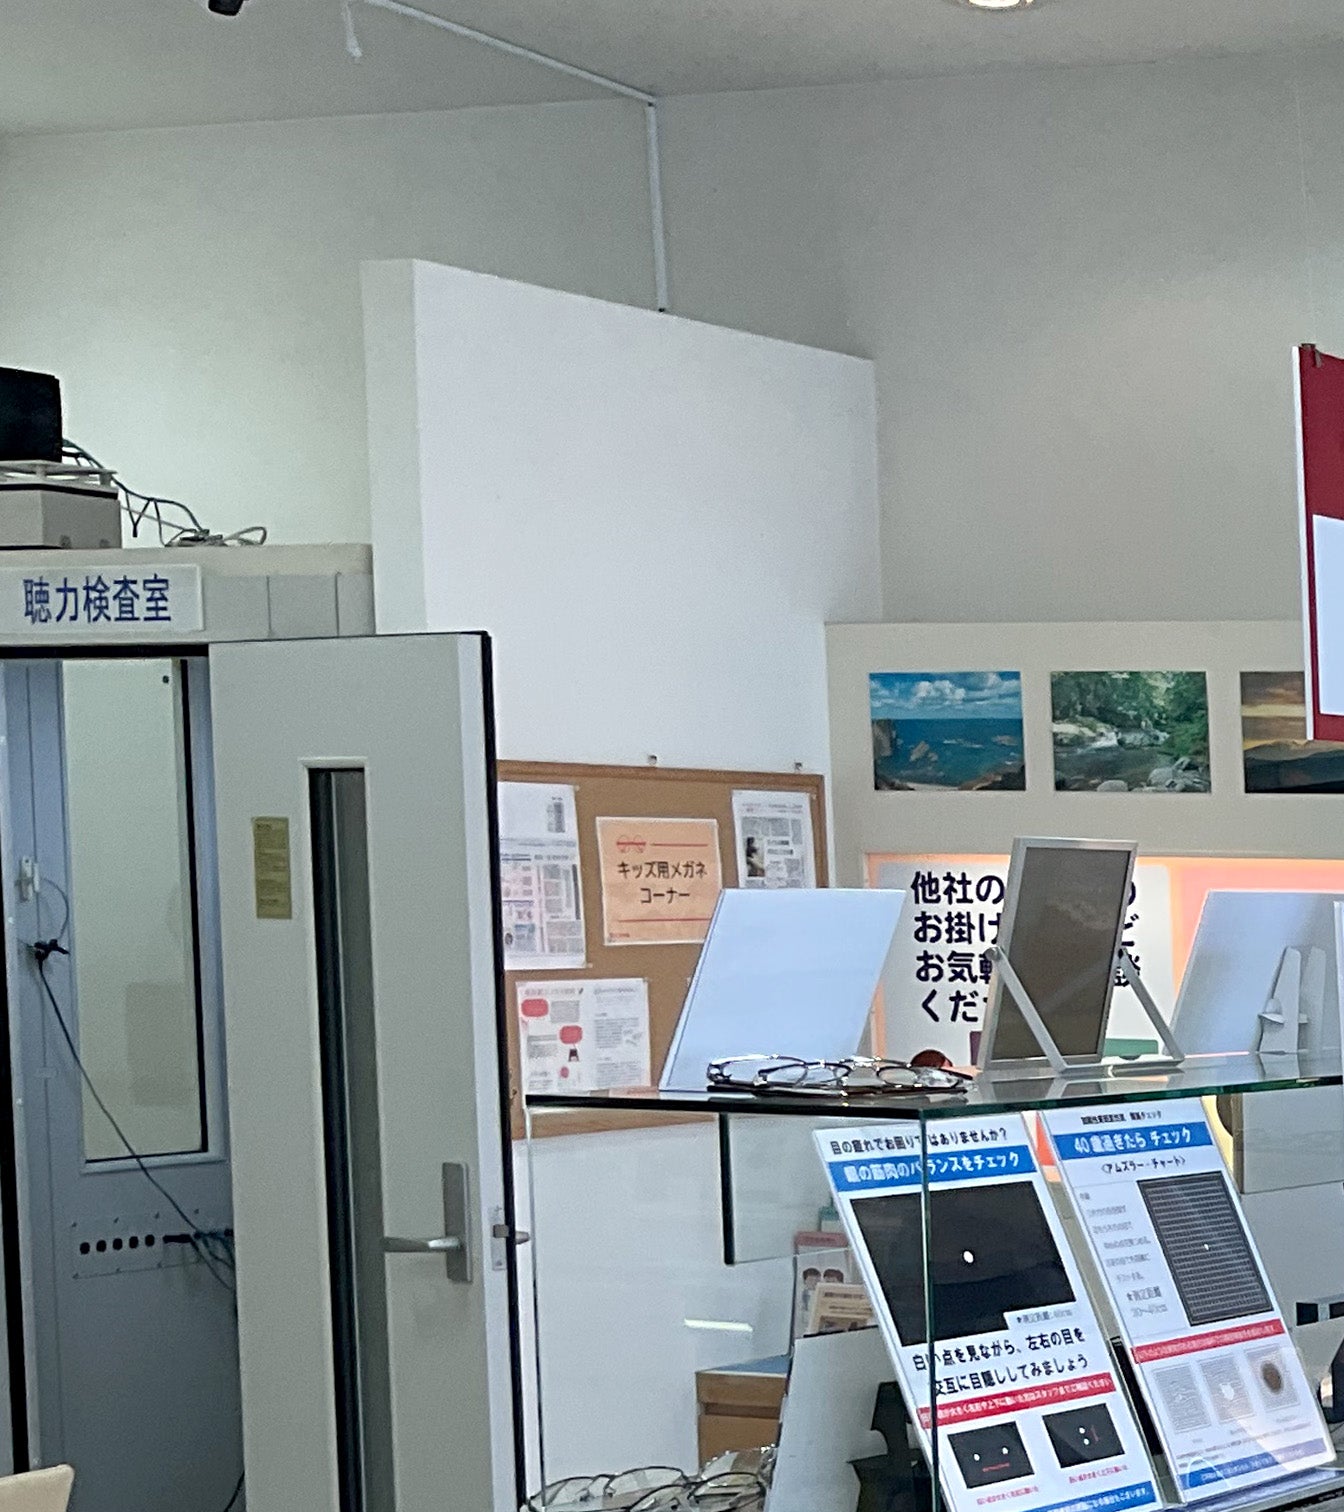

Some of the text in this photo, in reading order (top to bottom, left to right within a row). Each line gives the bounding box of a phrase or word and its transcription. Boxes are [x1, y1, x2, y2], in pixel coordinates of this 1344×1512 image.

[22, 573, 172, 626] 聴力検査室
[617, 860, 708, 880] キッズ用メガネ
[640, 887, 690, 905] コーナー
